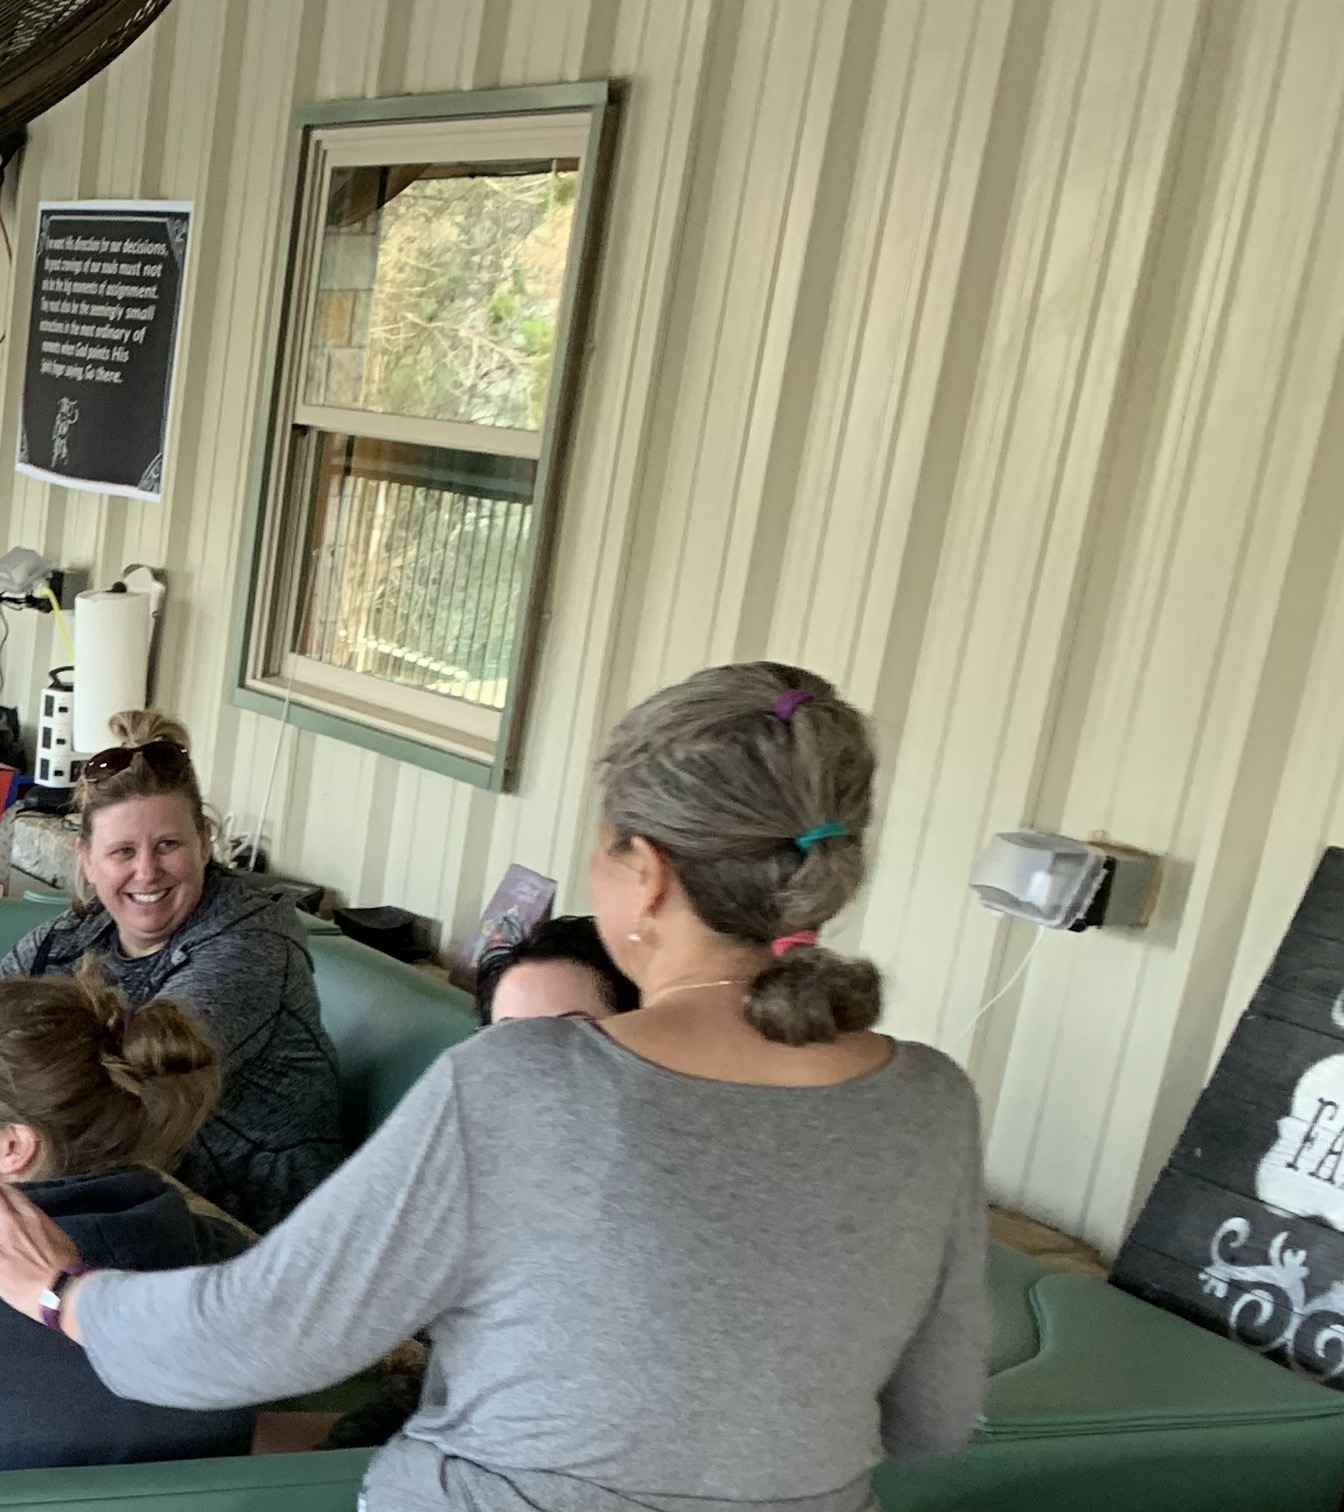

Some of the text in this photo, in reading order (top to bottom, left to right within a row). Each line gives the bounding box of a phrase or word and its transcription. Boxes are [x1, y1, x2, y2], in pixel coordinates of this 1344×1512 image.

[122, 238, 169, 257] decisions,
[118, 261, 142, 276] must
[143, 263, 163, 278] not
[98, 280, 107, 296] of
[105, 281, 159, 300] assignment.
[126, 305, 156, 320] small
[95, 323, 131, 343] ordinary
[133, 326, 146, 344] of
[111, 346, 130, 362] His
[94, 367, 123, 383] there.
